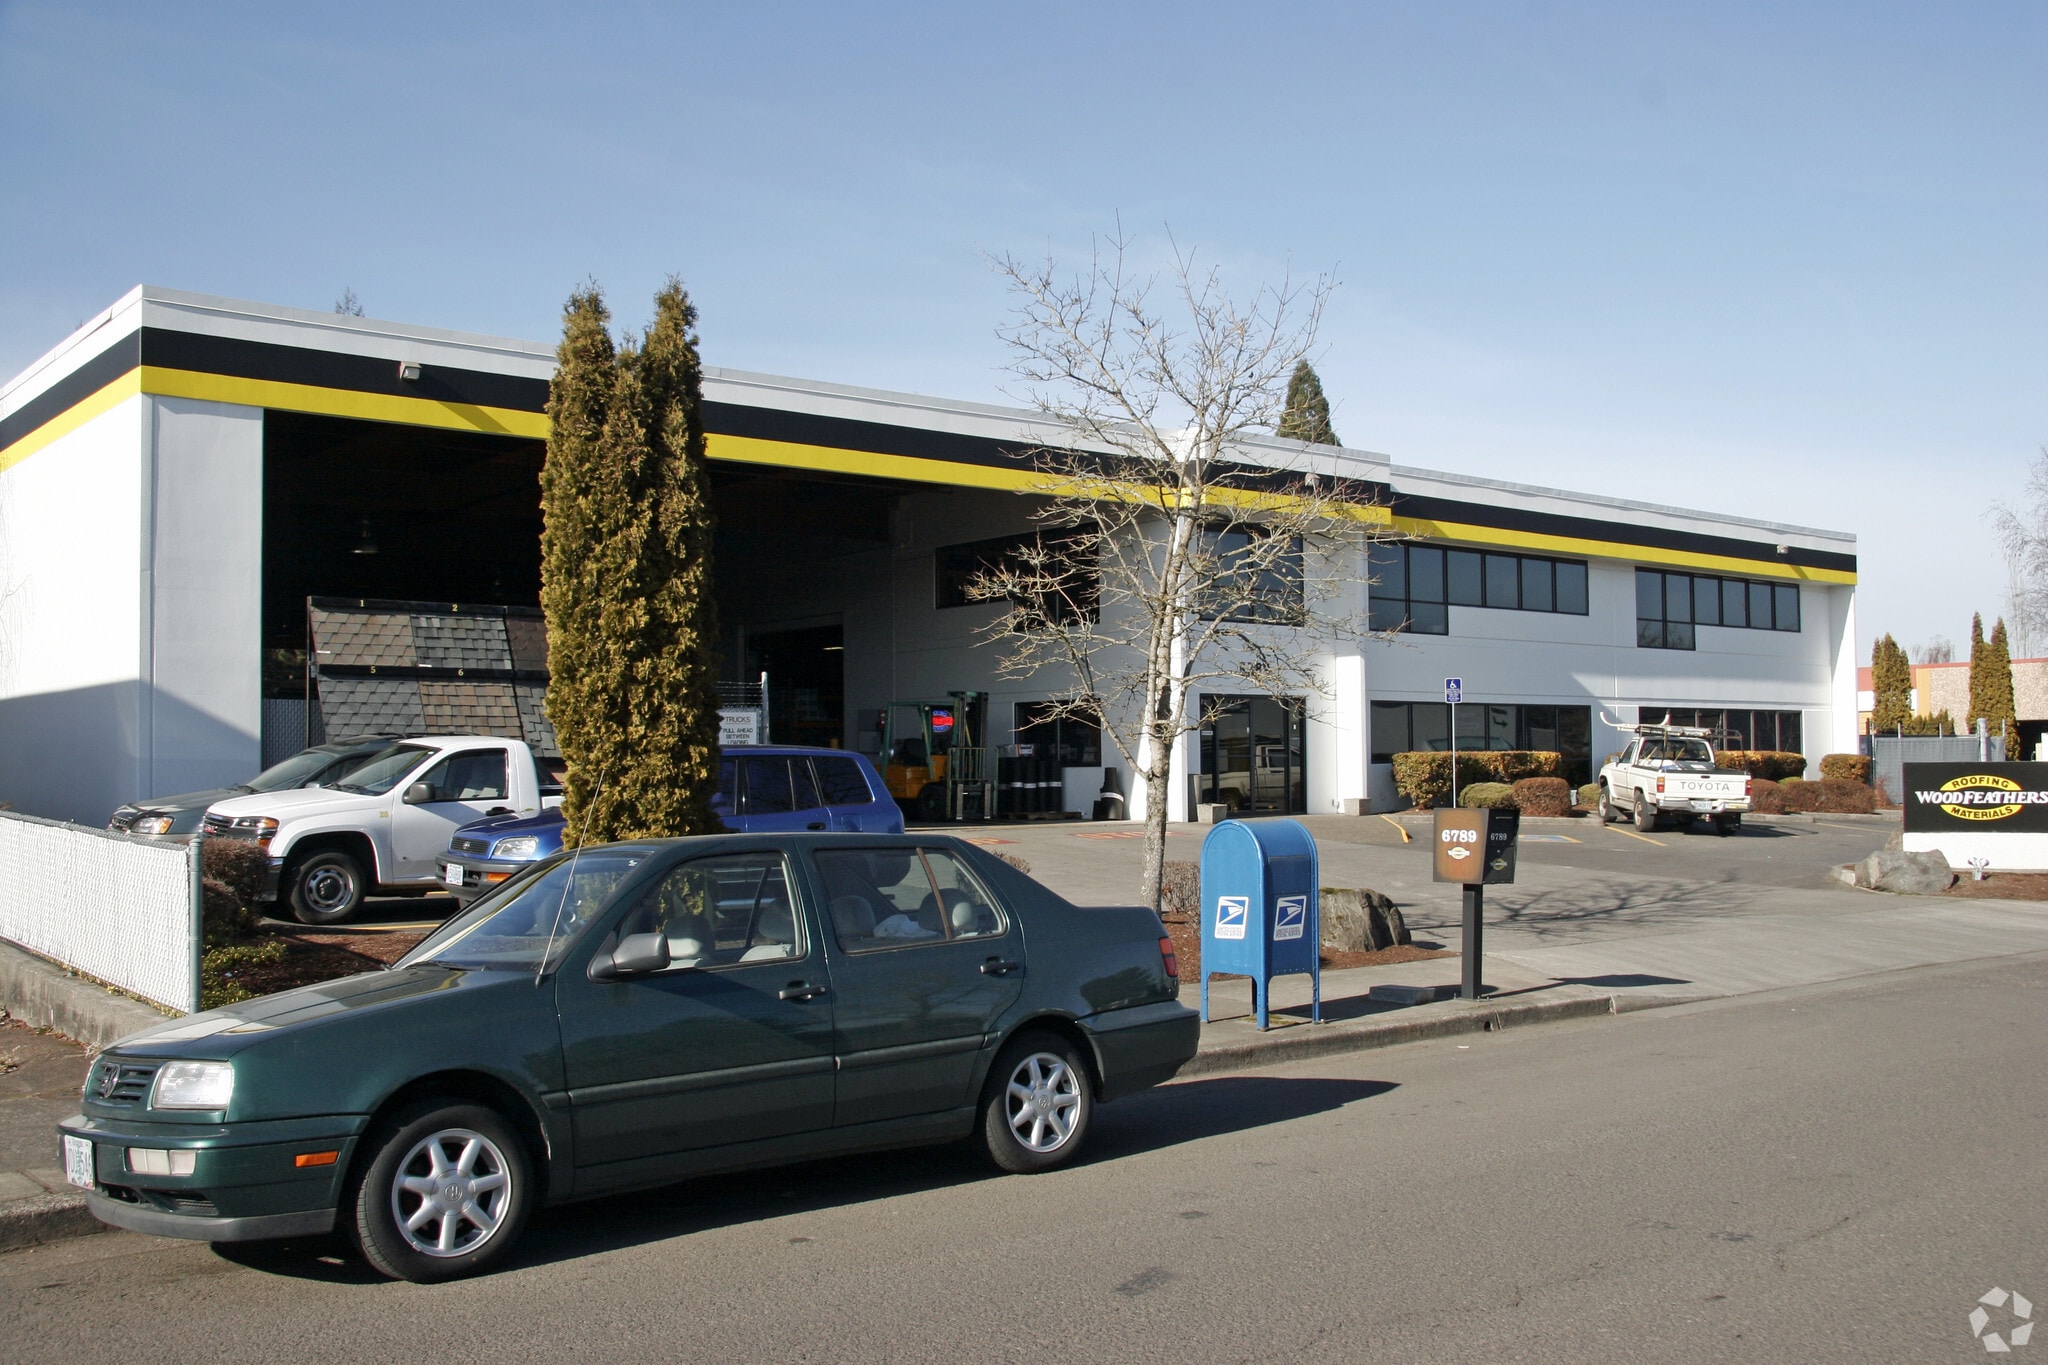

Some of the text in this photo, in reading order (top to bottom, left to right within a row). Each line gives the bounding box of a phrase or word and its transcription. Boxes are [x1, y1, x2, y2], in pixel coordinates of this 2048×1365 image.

[452, 604, 458, 612] 2
[370, 666, 376, 674] 5
[458, 669, 464, 677] 6
[1680, 781, 1730, 792] TOYOTA
[1951, 776, 2010, 789] ROOFING
[1914, 790, 2048, 805] WOODFEATHERS
[1950, 806, 2013, 819] MATERIALS
[1441, 829, 1477, 843] 6789
[1490, 832, 1508, 841] 6789
